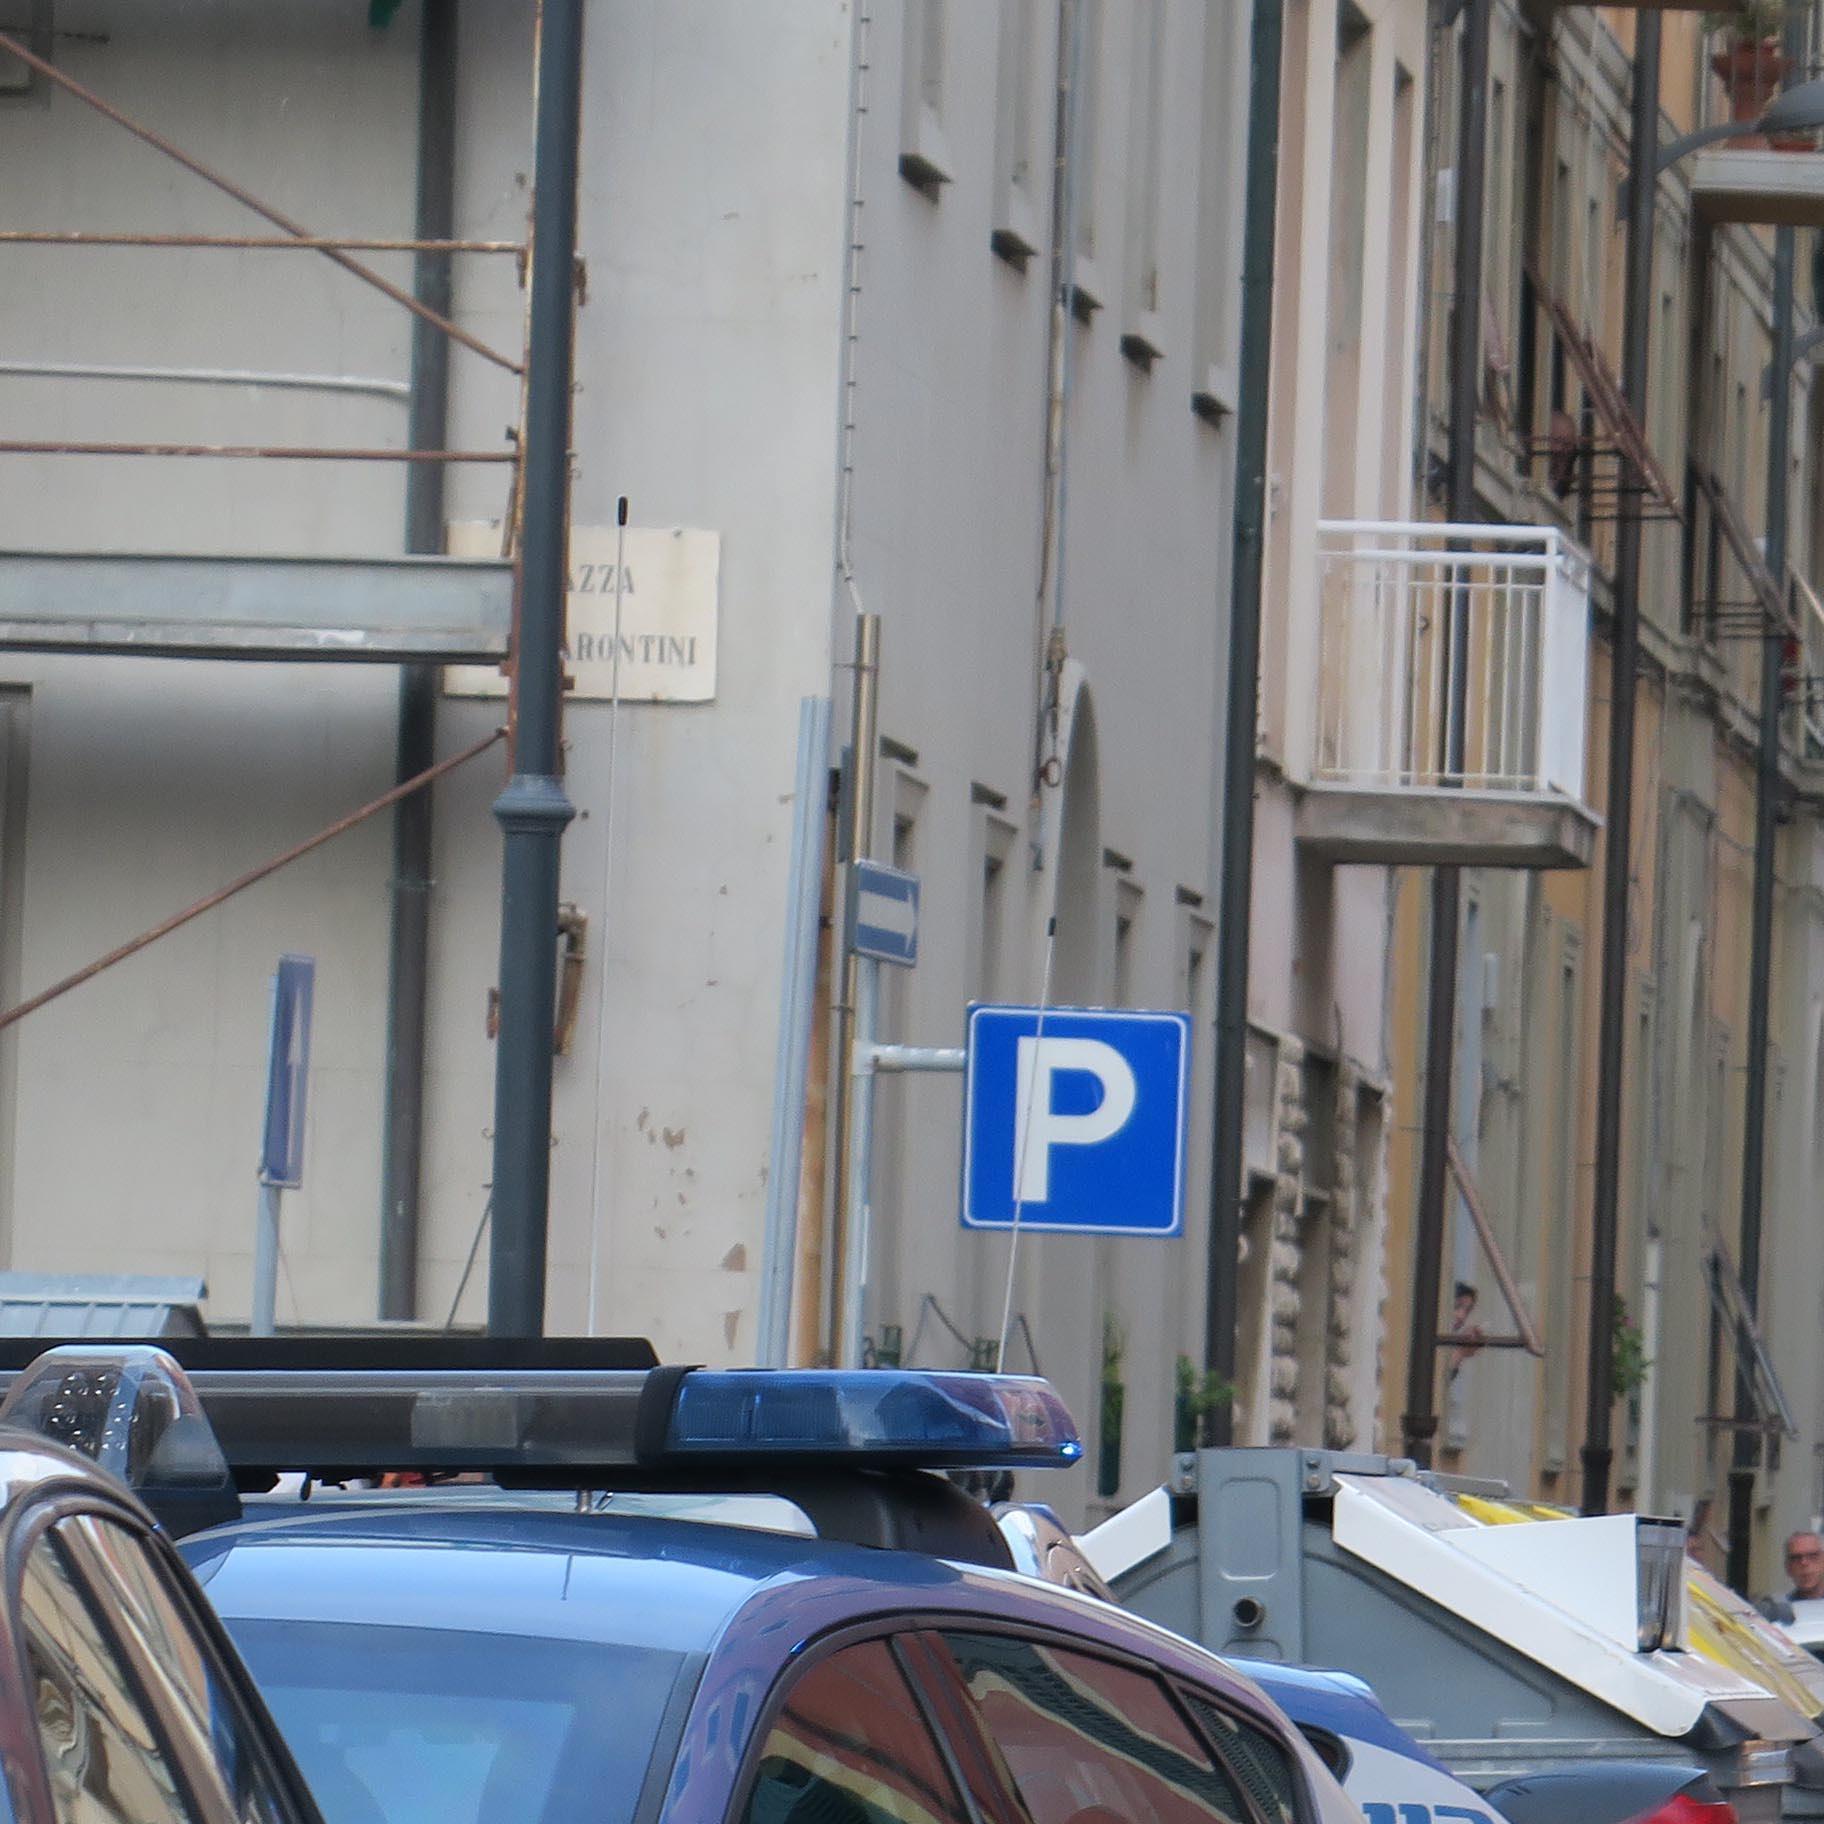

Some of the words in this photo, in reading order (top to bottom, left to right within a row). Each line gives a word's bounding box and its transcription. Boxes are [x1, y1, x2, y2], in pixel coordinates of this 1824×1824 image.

[566, 564, 635, 594] ZZA
[562, 632, 697, 666] RONTINI
[1013, 1036, 1137, 1202] P
